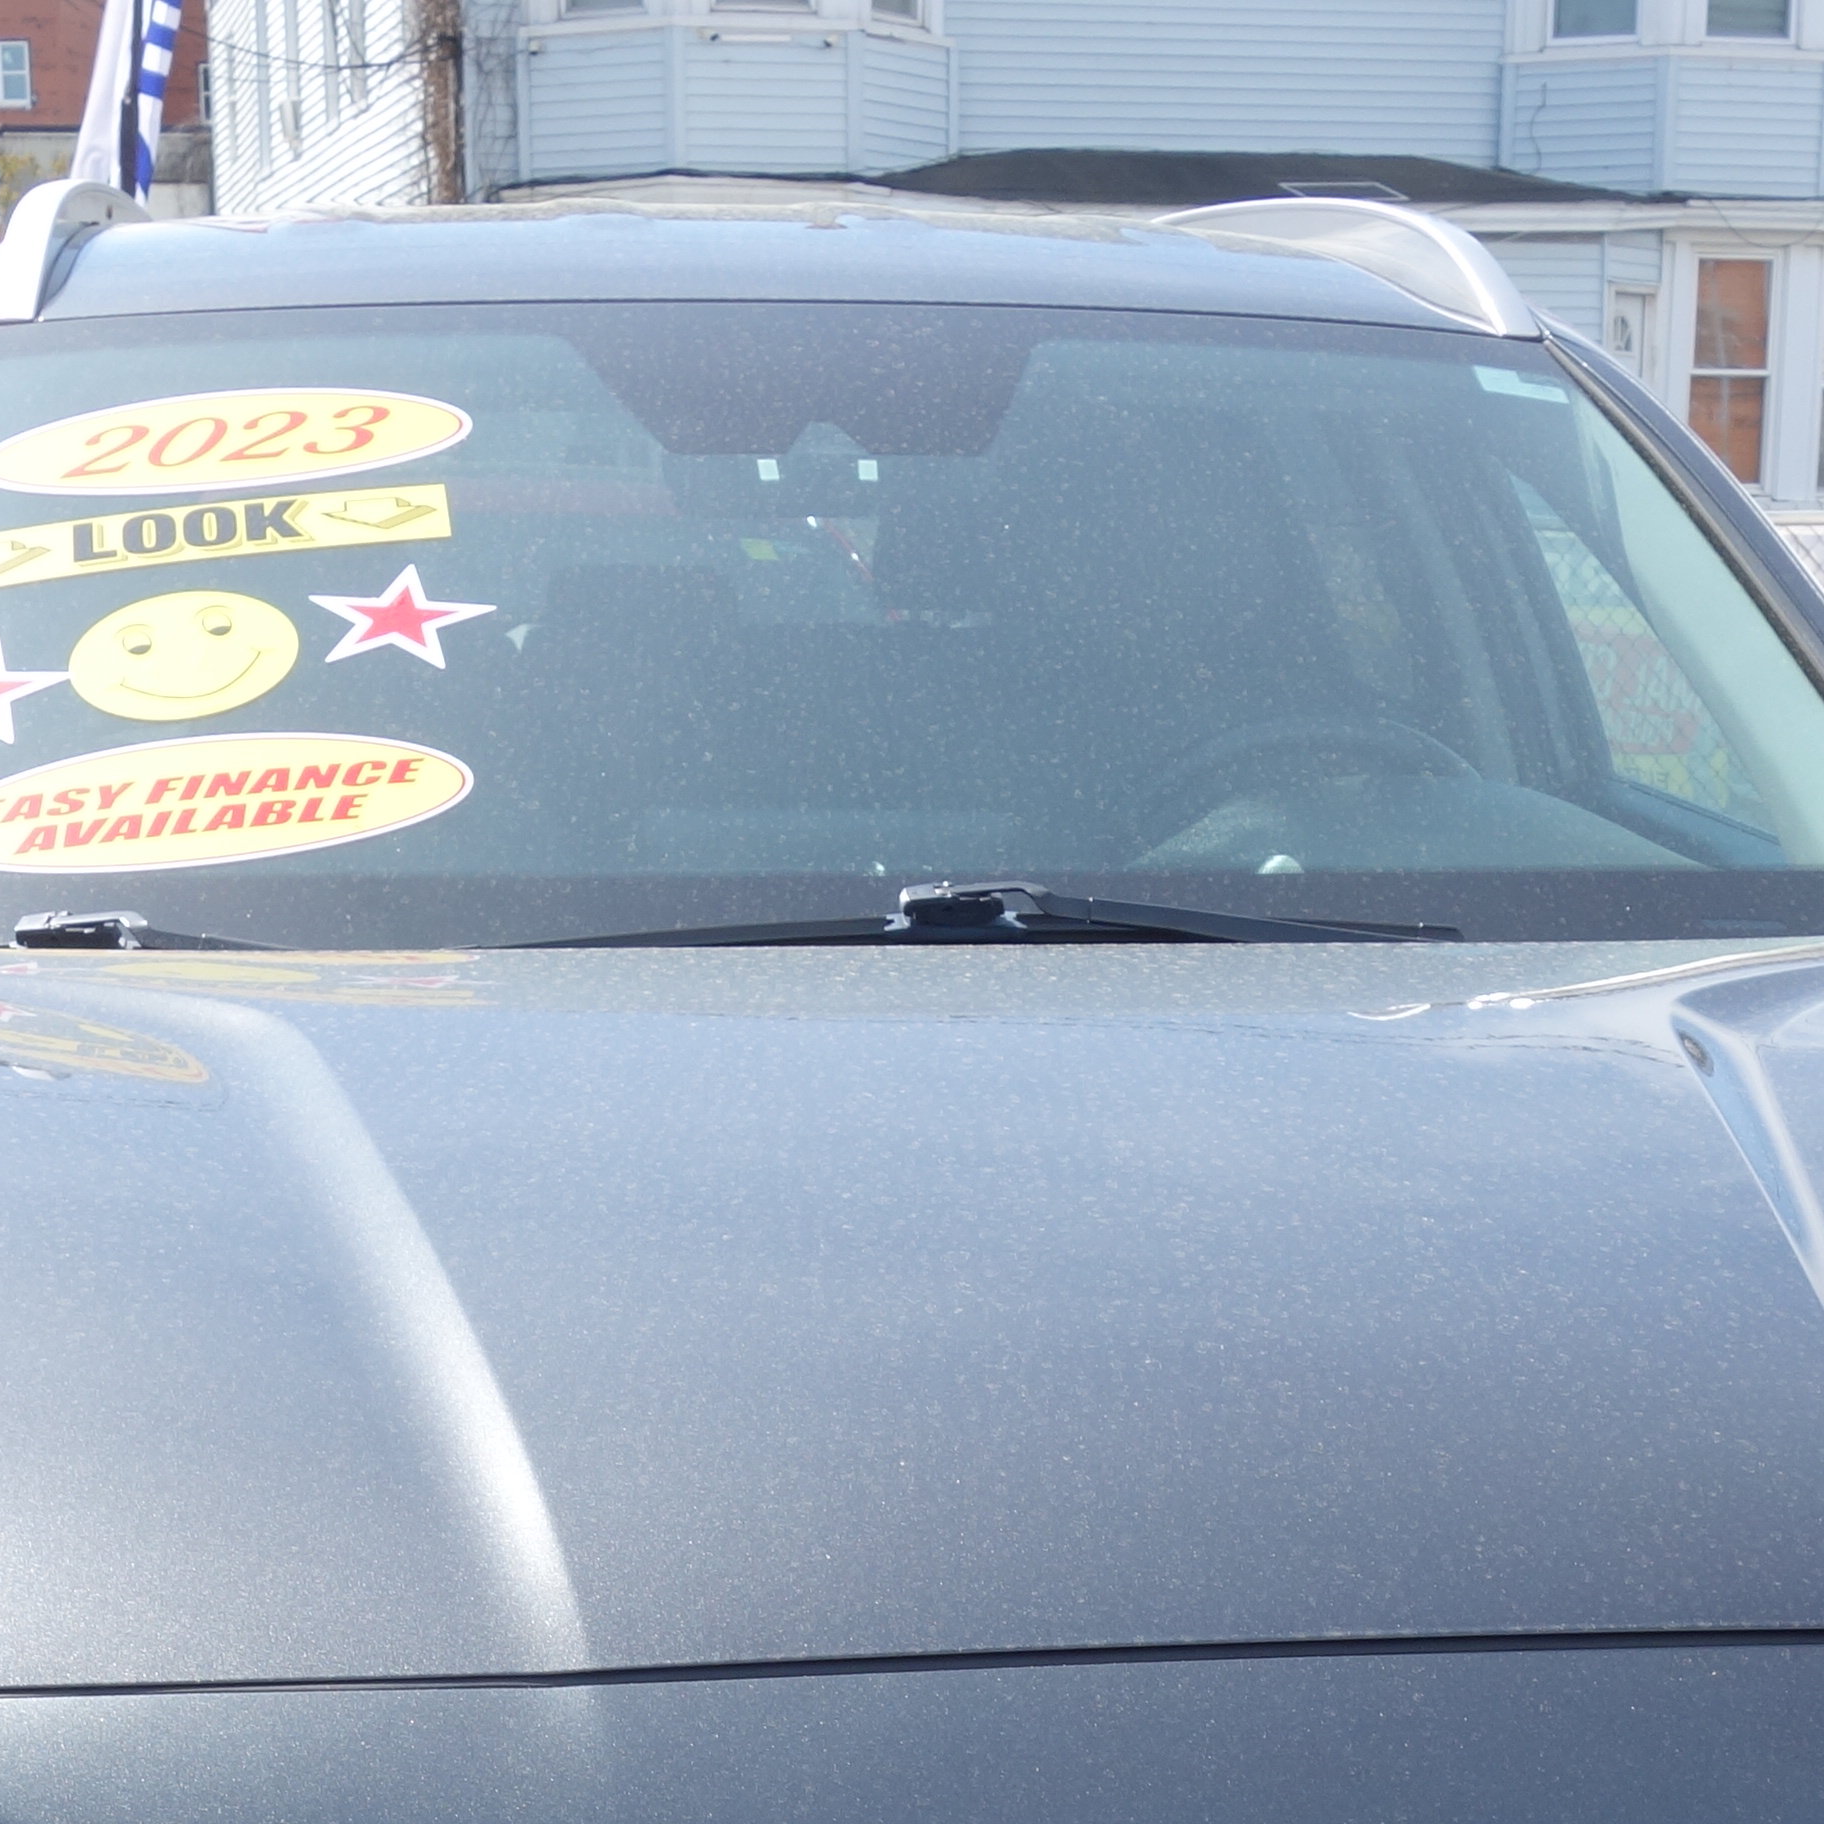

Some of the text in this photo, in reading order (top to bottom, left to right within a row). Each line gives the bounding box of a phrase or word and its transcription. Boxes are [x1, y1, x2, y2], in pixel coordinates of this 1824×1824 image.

[61, 406, 391, 479] 2023
[72, 498, 309, 564] LOOK
[144, 756, 426, 806] FINANCE
[12, 793, 370, 856] AVAILABLE
